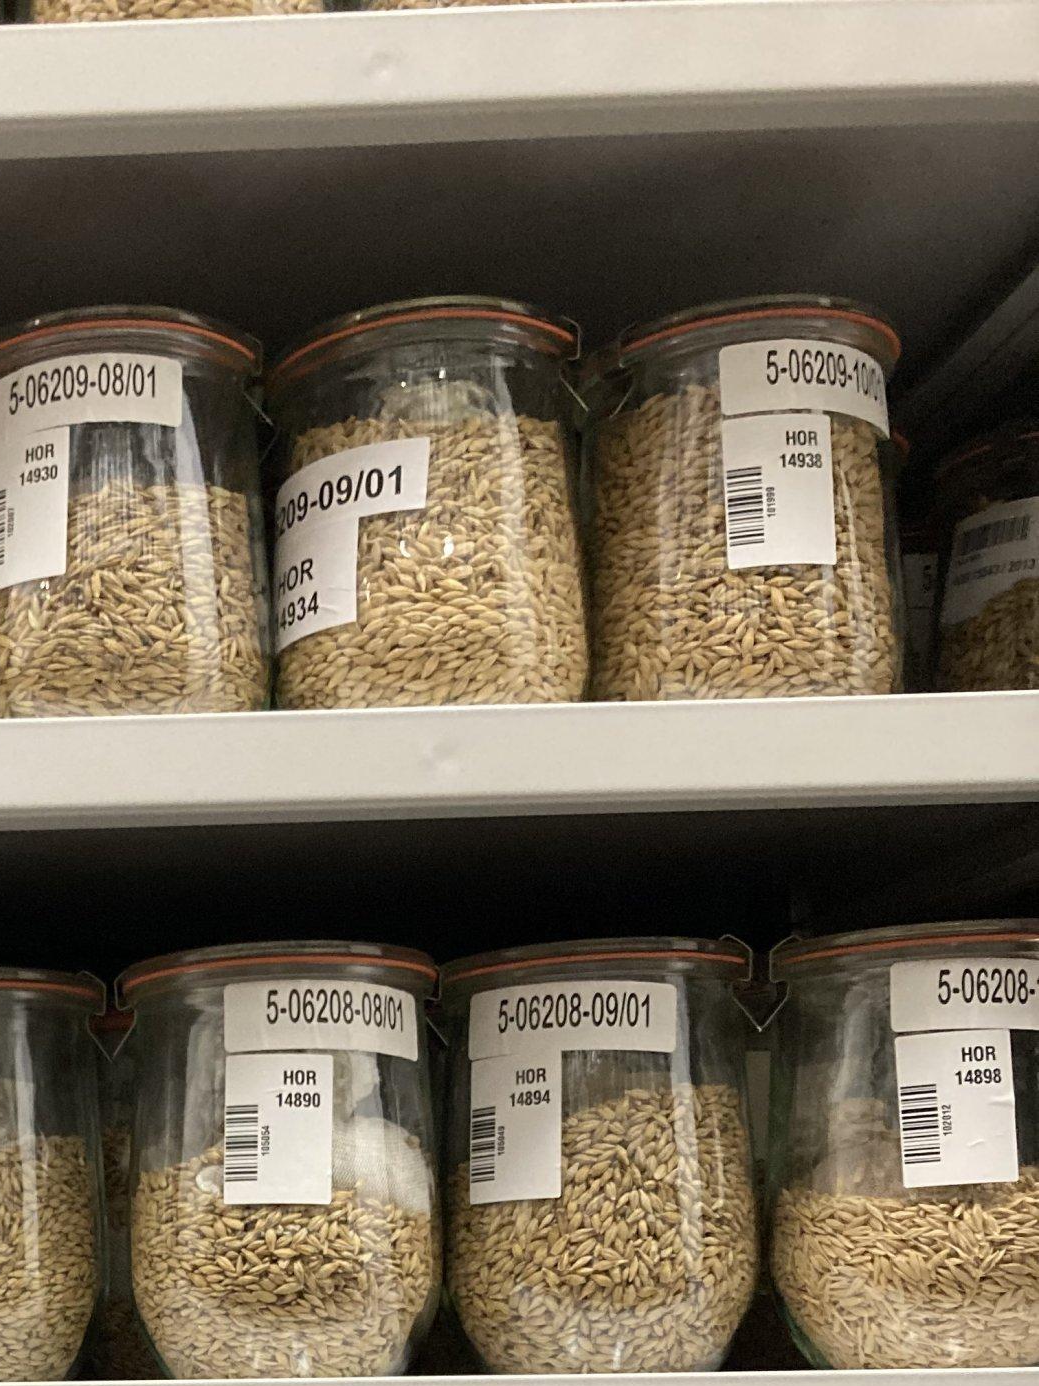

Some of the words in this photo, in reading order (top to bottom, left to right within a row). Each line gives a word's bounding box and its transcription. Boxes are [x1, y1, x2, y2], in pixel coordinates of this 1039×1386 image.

[9, 363, 156, 414] 5-06209-08/01
[785, 430, 818, 446] HOR
[25, 442, 55, 461] HOR
[779, 452, 823, 469] 14938
[18, 464, 59, 486] 14930
[266, 986, 405, 1033] 5-06208-08/01
[497, 991, 651, 1033] 5-06208-09/01
[961, 1046, 997, 1063] HOR
[282, 1069, 317, 1086] HOR
[515, 1067, 547, 1085] HOR
[954, 1068, 1002, 1086] 14898
[275, 1091, 321, 1109] 14890
[508, 1089, 551, 1107] 14894
